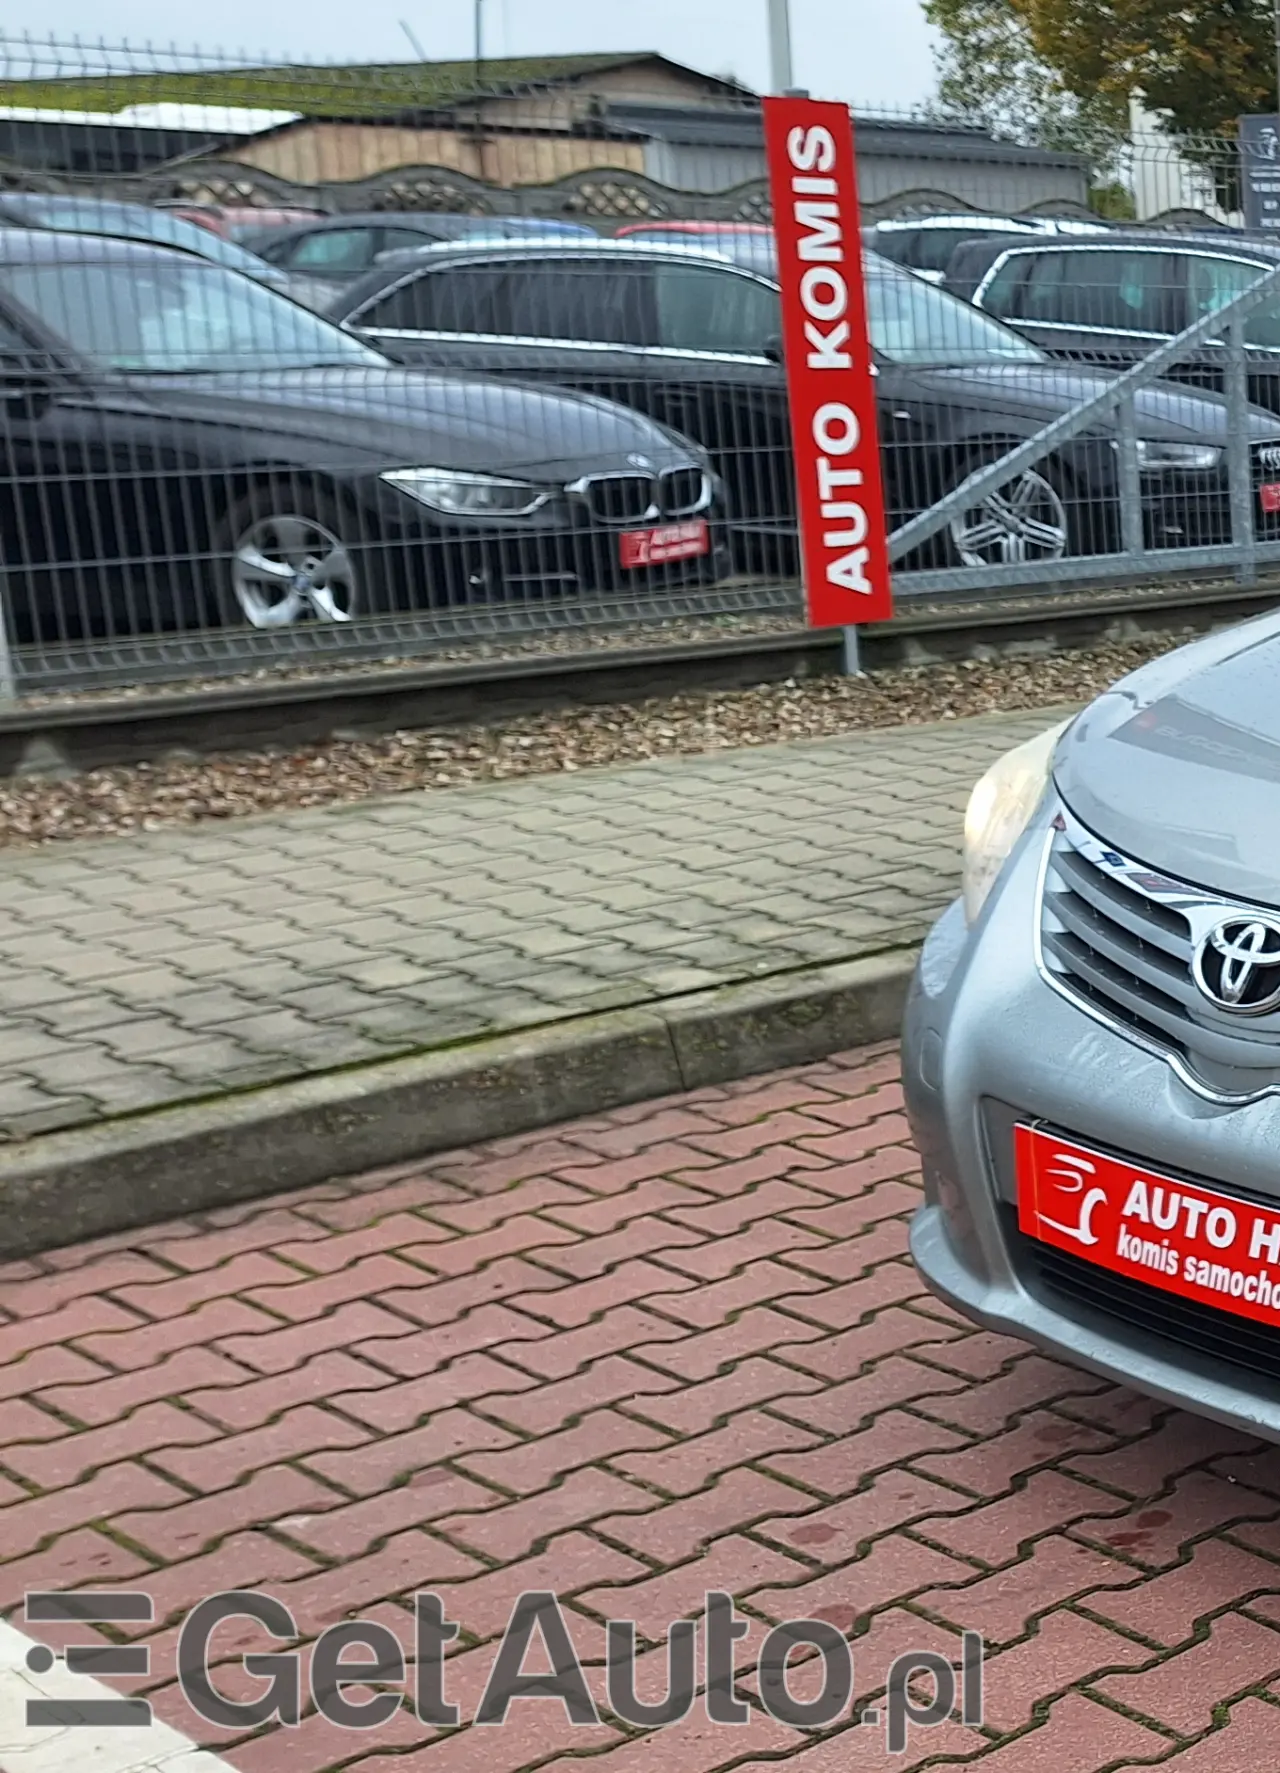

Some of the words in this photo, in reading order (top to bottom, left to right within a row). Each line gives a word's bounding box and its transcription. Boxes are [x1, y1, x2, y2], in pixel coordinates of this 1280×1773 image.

[786, 124, 852, 370] KOMIS
[811, 401, 874, 596] AUTO
[1115, 1224, 1181, 1277] komis
[1121, 1179, 1237, 1249] AUTO
